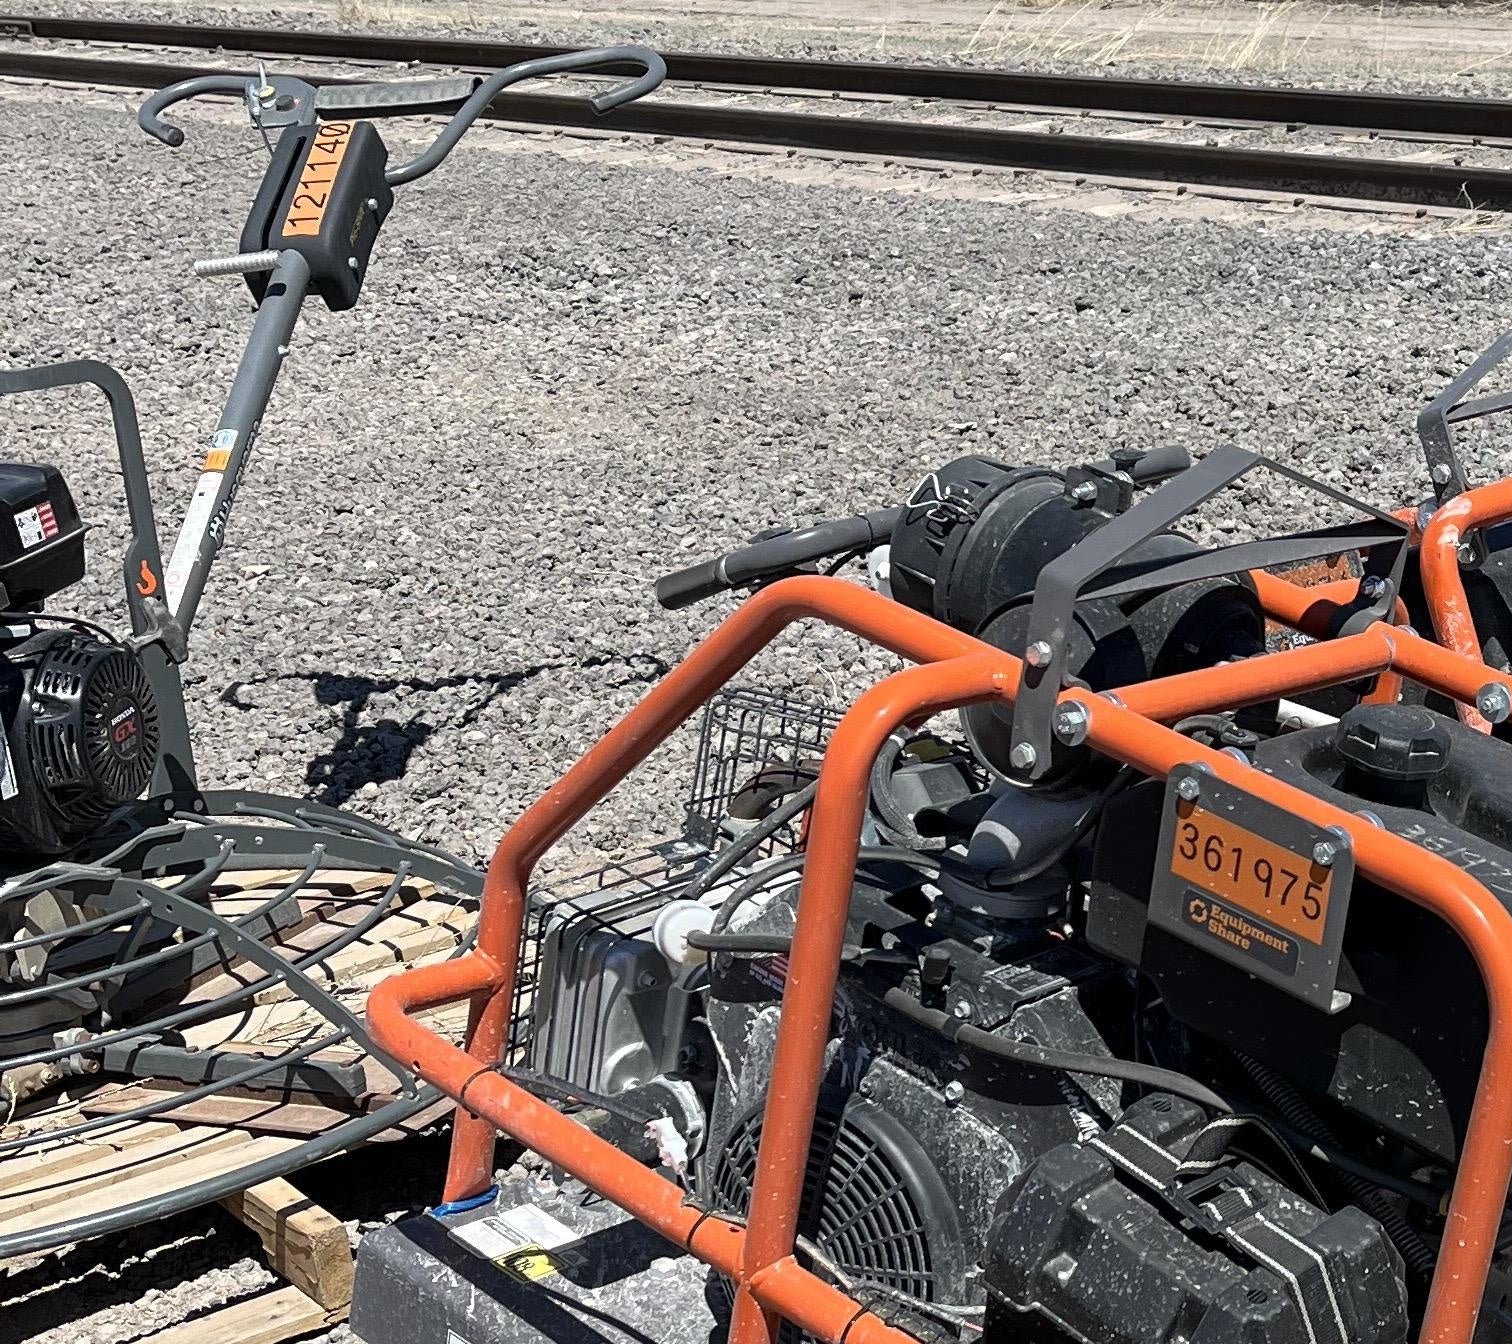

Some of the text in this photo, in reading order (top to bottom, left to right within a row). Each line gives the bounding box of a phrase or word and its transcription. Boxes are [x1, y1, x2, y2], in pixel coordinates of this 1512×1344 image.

[287, 122, 351, 227] 121140
[111, 706, 135, 726] HONDA
[1178, 822, 1323, 921] 361975
[1207, 918, 1251, 951] Share
[1210, 904, 1289, 955] Equipment
